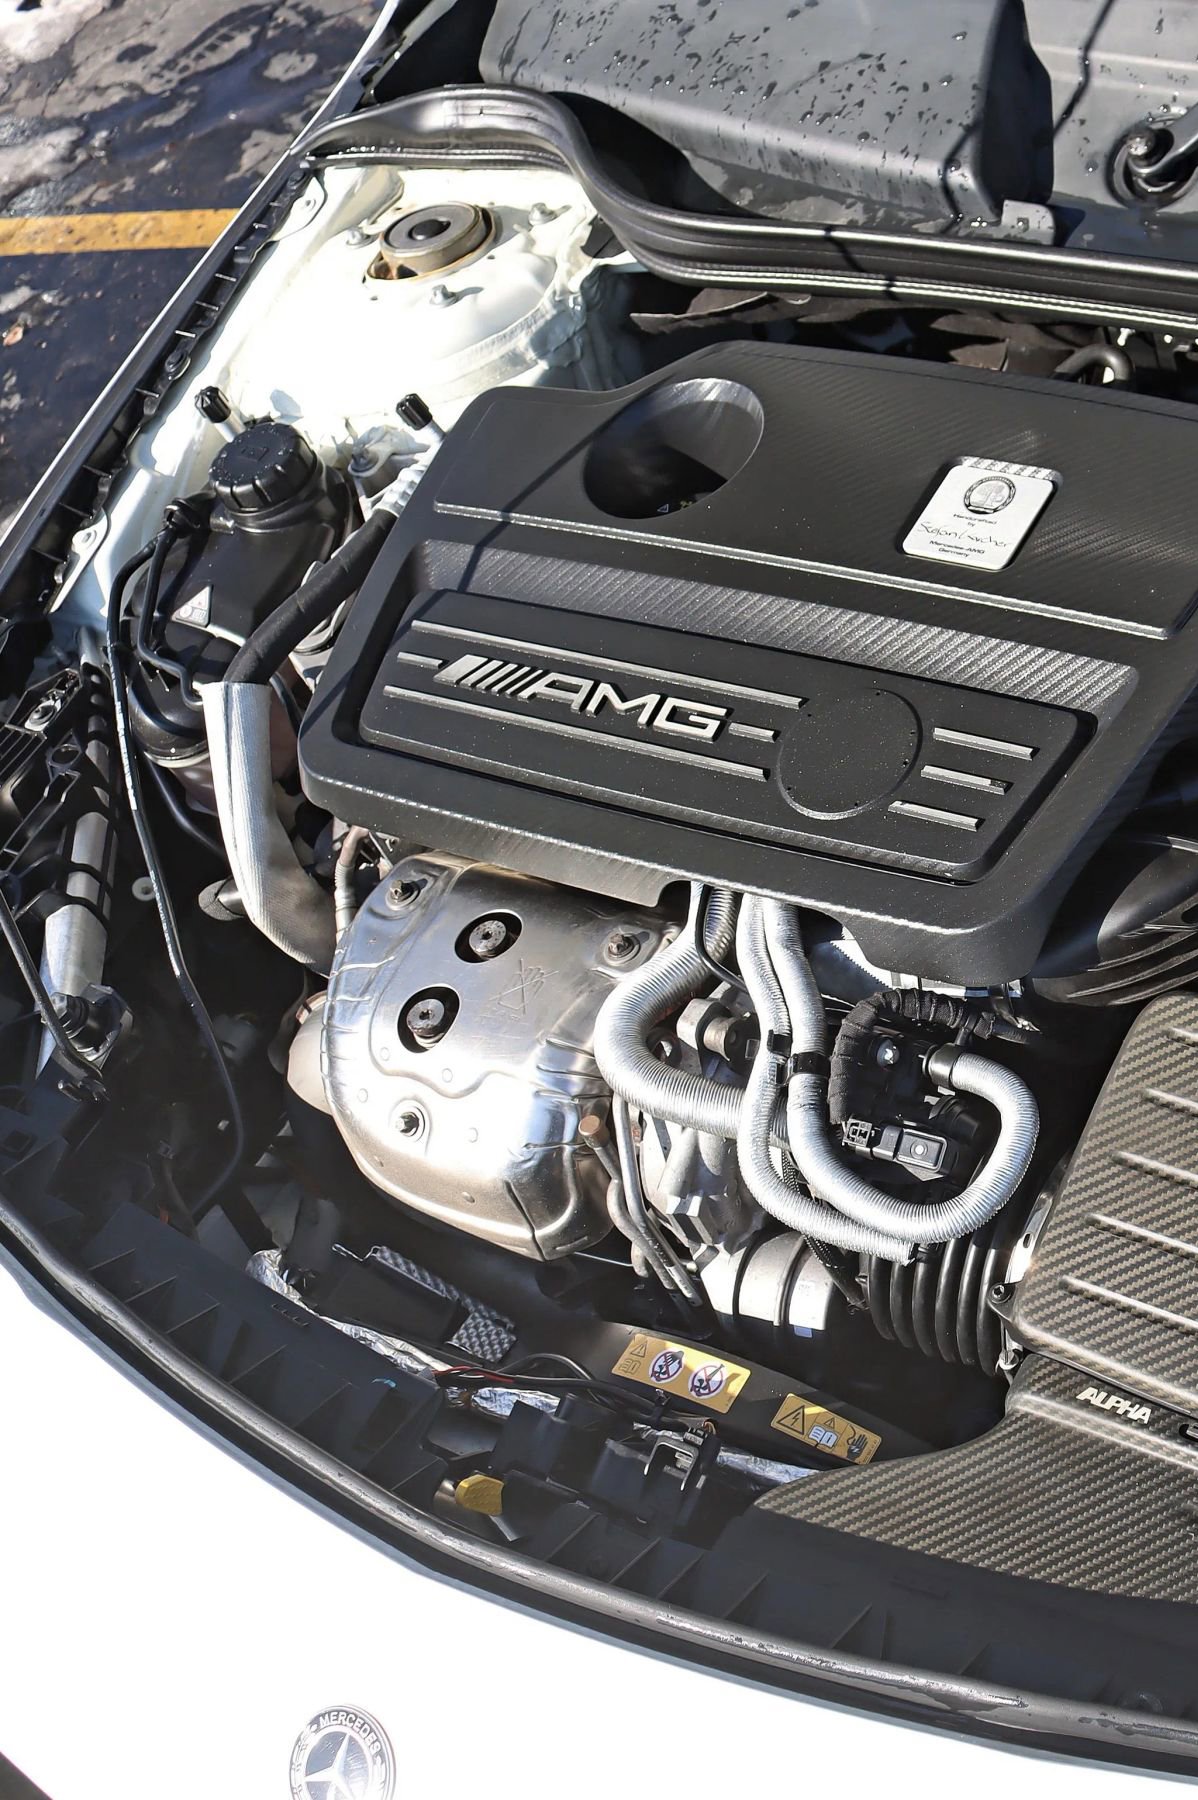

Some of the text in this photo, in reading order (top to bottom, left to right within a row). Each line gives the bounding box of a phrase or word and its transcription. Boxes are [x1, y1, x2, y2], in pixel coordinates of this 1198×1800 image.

[929, 540, 985, 554] Mercedes-AMG
[937, 547, 970, 557] Germany
[517, 671, 728, 743] AMG
[1076, 1387, 1152, 1424] ALPHA
[319, 1711, 382, 1756] MERCEDES
